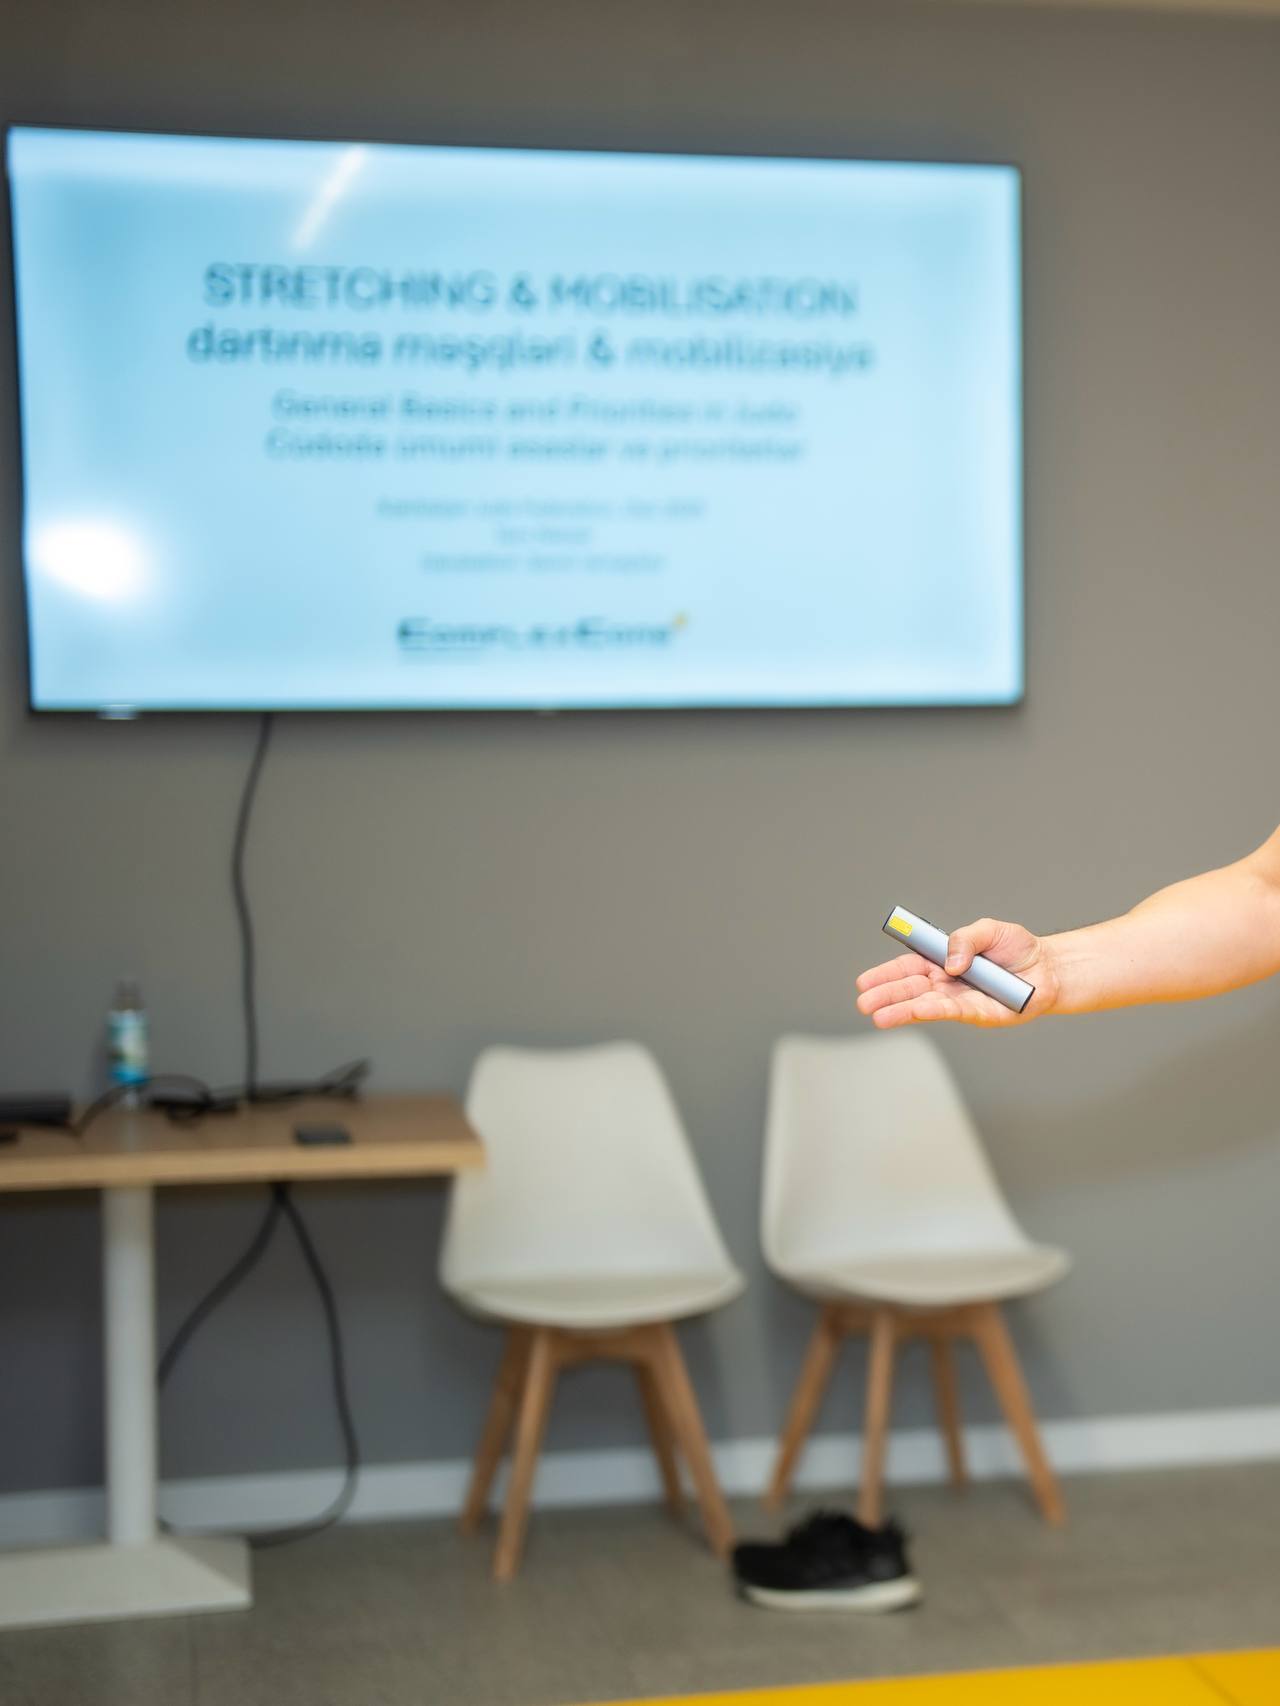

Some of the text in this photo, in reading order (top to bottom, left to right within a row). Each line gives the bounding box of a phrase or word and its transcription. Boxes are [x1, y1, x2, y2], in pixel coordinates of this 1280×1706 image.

[203, 263, 861, 317] STRETCHING & MOBILISATION
